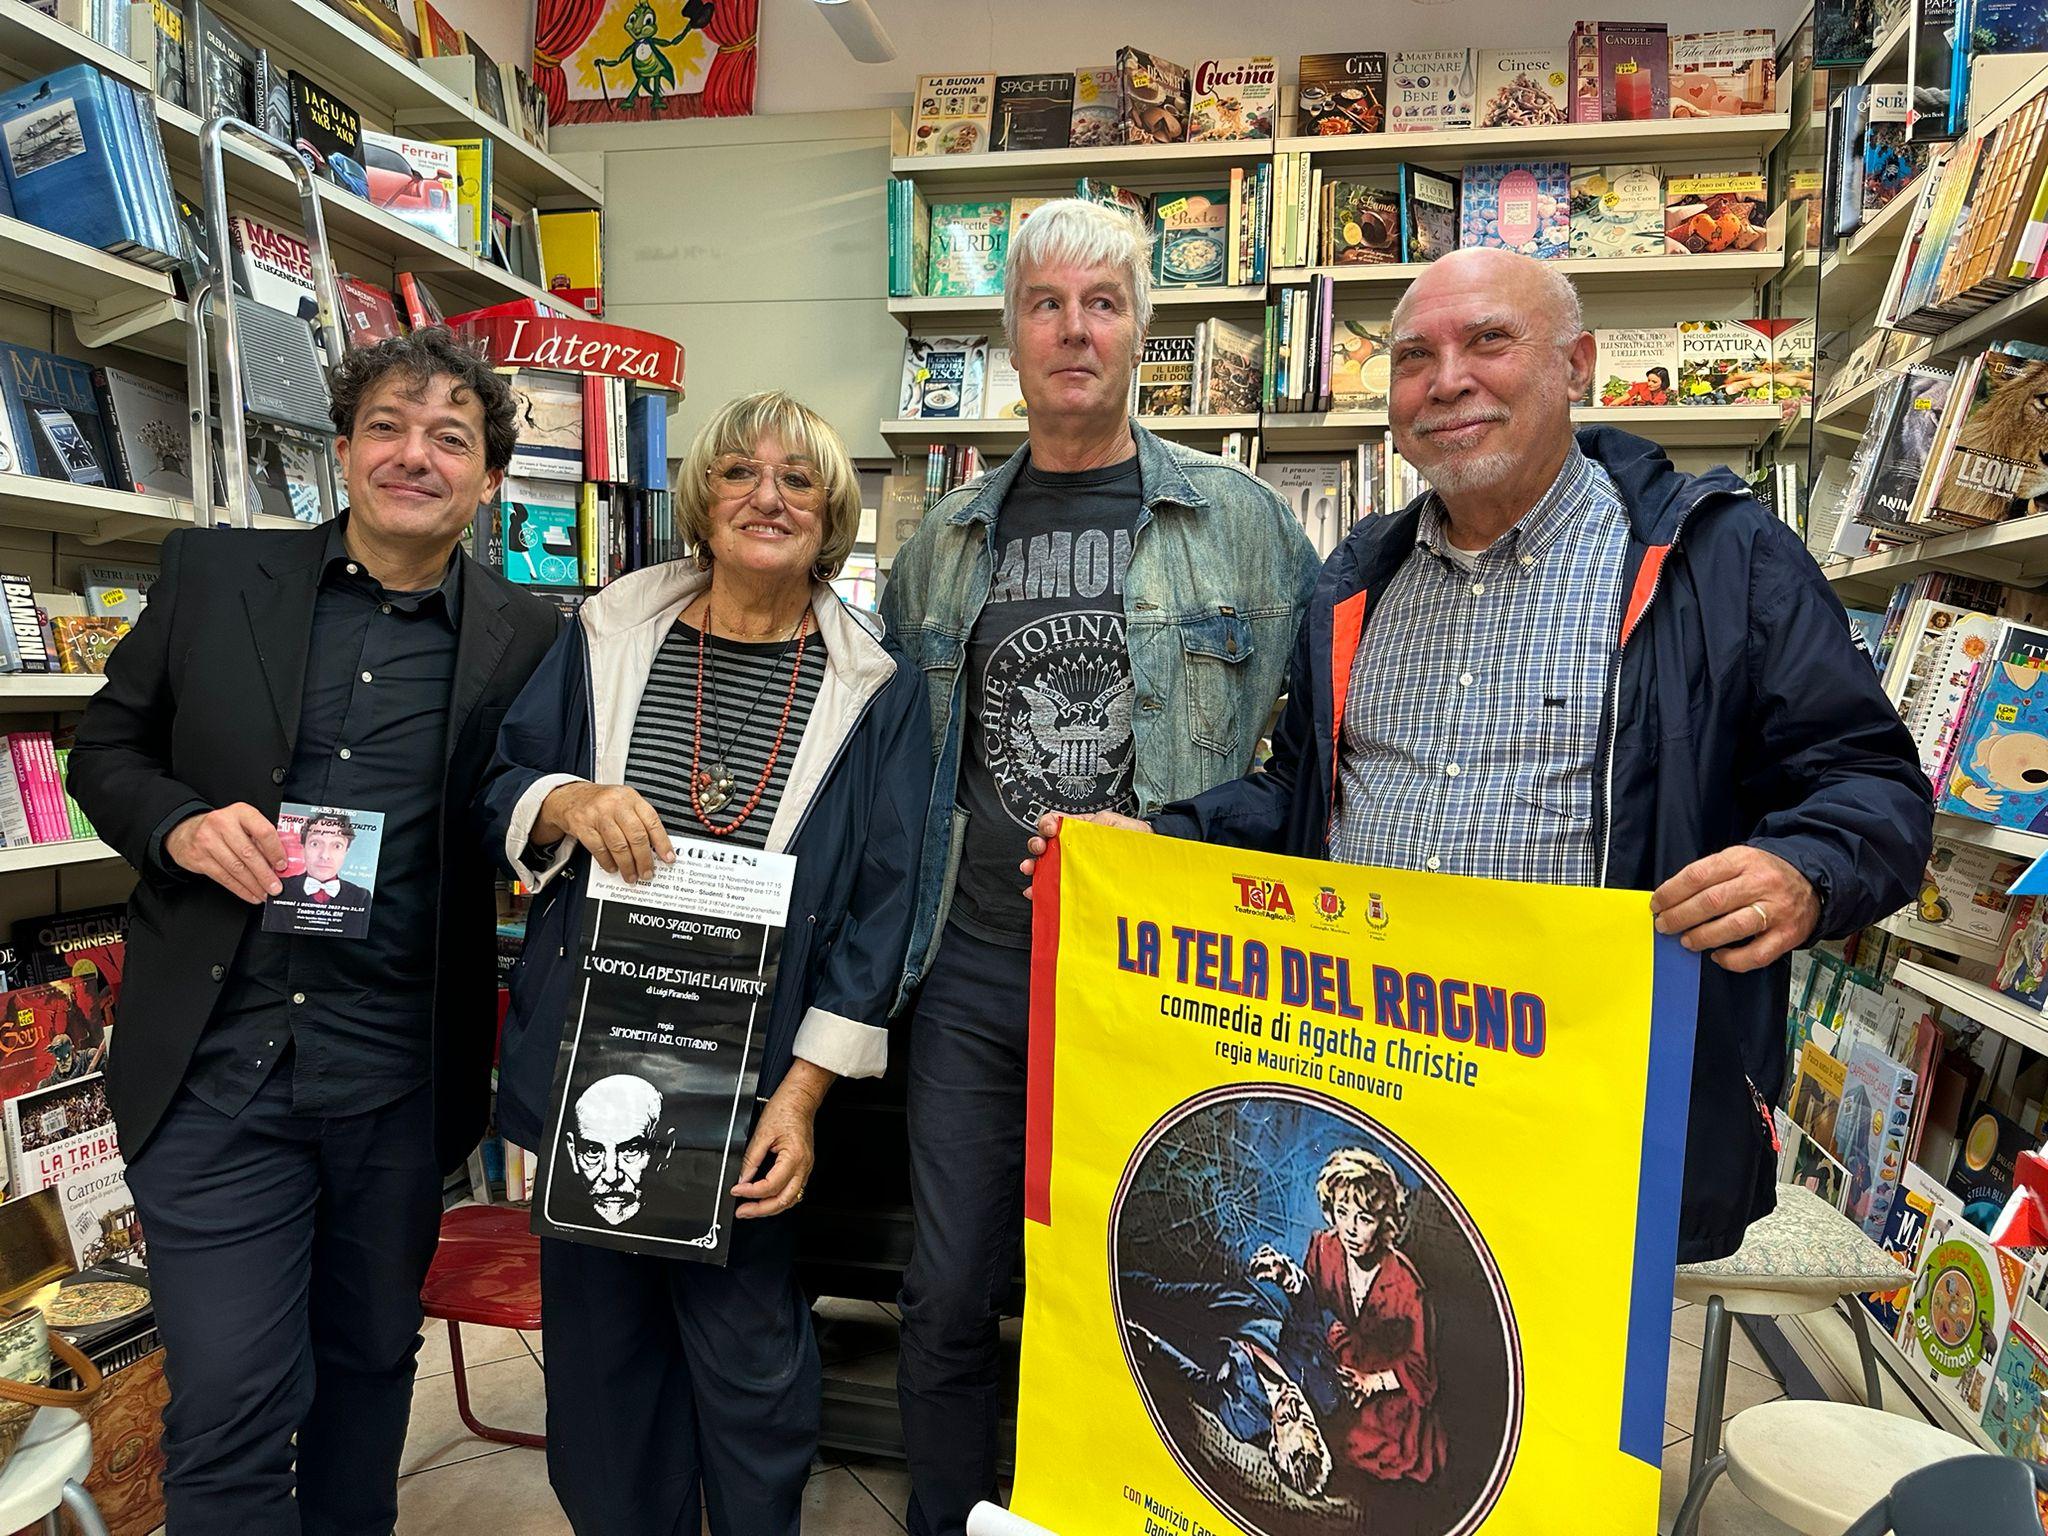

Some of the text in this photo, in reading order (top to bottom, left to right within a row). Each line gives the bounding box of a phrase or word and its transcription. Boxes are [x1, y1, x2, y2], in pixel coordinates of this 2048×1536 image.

[1605, 34, 1652, 46] CANDELE
[1405, 51, 1465, 62] MARY BERRY
[1709, 43, 1722, 55] da
[1727, 44, 1770, 57] ricamare
[1253, 63, 1274, 71] grande
[1345, 57, 1382, 74] CINA
[1392, 61, 1462, 75] CUCINARE
[1498, 59, 1551, 72] Cinese
[929, 77, 985, 87] LA BUONA
[1147, 64, 1185, 91] DESSERT
[1196, 60, 1275, 96] Cucina
[935, 86, 977, 96] CUCINA
[1001, 79, 1069, 94] SPAGHETTI
[1403, 91, 1439, 102] BENE
[304, 86, 358, 133] JAGUAR
[401, 143, 449, 162] Ferrari
[1419, 183, 1450, 200] FIORI
[1623, 183, 1649, 192] CREA
[953, 220, 988, 231] Ricette
[1171, 211, 1221, 226] Pasta
[938, 234, 1001, 252] VERDI
[250, 241, 300, 275] OF THE
[504, 319, 660, 379] Laterza
[1683, 339, 1767, 353] POTATURA
[1152, 373, 1171, 381] DEI
[1166, 365, 1193, 374] LIBRO
[1957, 452, 2026, 493] LEONI
[92, 569, 122, 580] VETRI
[4, 583, 47, 660] BAMBINI
[1113, 684, 1125, 693] GO
[985, 676, 1016, 791] RICHIE
[333, 808, 357, 817] TEATRO
[282, 816, 305, 825] SONO
[321, 820, 346, 829] UOMO
[348, 822, 377, 832] FINITO
[688, 847, 757, 867] CRAL ENI
[688, 877, 716, 888] Domenica
[726, 884, 753, 894] Novembre
[689, 869, 717, 880] Domenica
[727, 875, 755, 886] Novembre
[651, 891, 674, 899] chiamare
[680, 886, 695, 894] euro
[1941, 883, 1948, 891] la
[1971, 906, 1988, 915] casa
[39, 916, 129, 947] OFFICINA
[629, 911, 741, 940] NUOVO SPAZIO TEATRO
[54, 931, 123, 955] TORINESE
[583, 955, 729, 991] L'UOMO, LA BESTIA E LA
[646, 985, 700, 1001] di Luigi Pirandello
[1117, 916, 1547, 1058] LA TELA DEL RAGNO
[657, 1021, 675, 1032] regia
[609, 1026, 718, 1052] SIMONETTA DEL CITTADINO
[1160, 993, 1478, 1087] commedia di Agatha Christie
[1215, 1038, 1403, 1101] regia Maurizio Canovaro
[40, 1137, 83, 1158] DESMOND
[40, 1154, 63, 1175] LA
[1989, 1166, 2001, 1178] PER
[66, 1168, 126, 1203] Carrozze
[1938, 1246, 1988, 1297] gioca con
[1917, 1314, 1975, 1369] gli animali
[1123, 1485, 1189, 1532] con Maurizio
